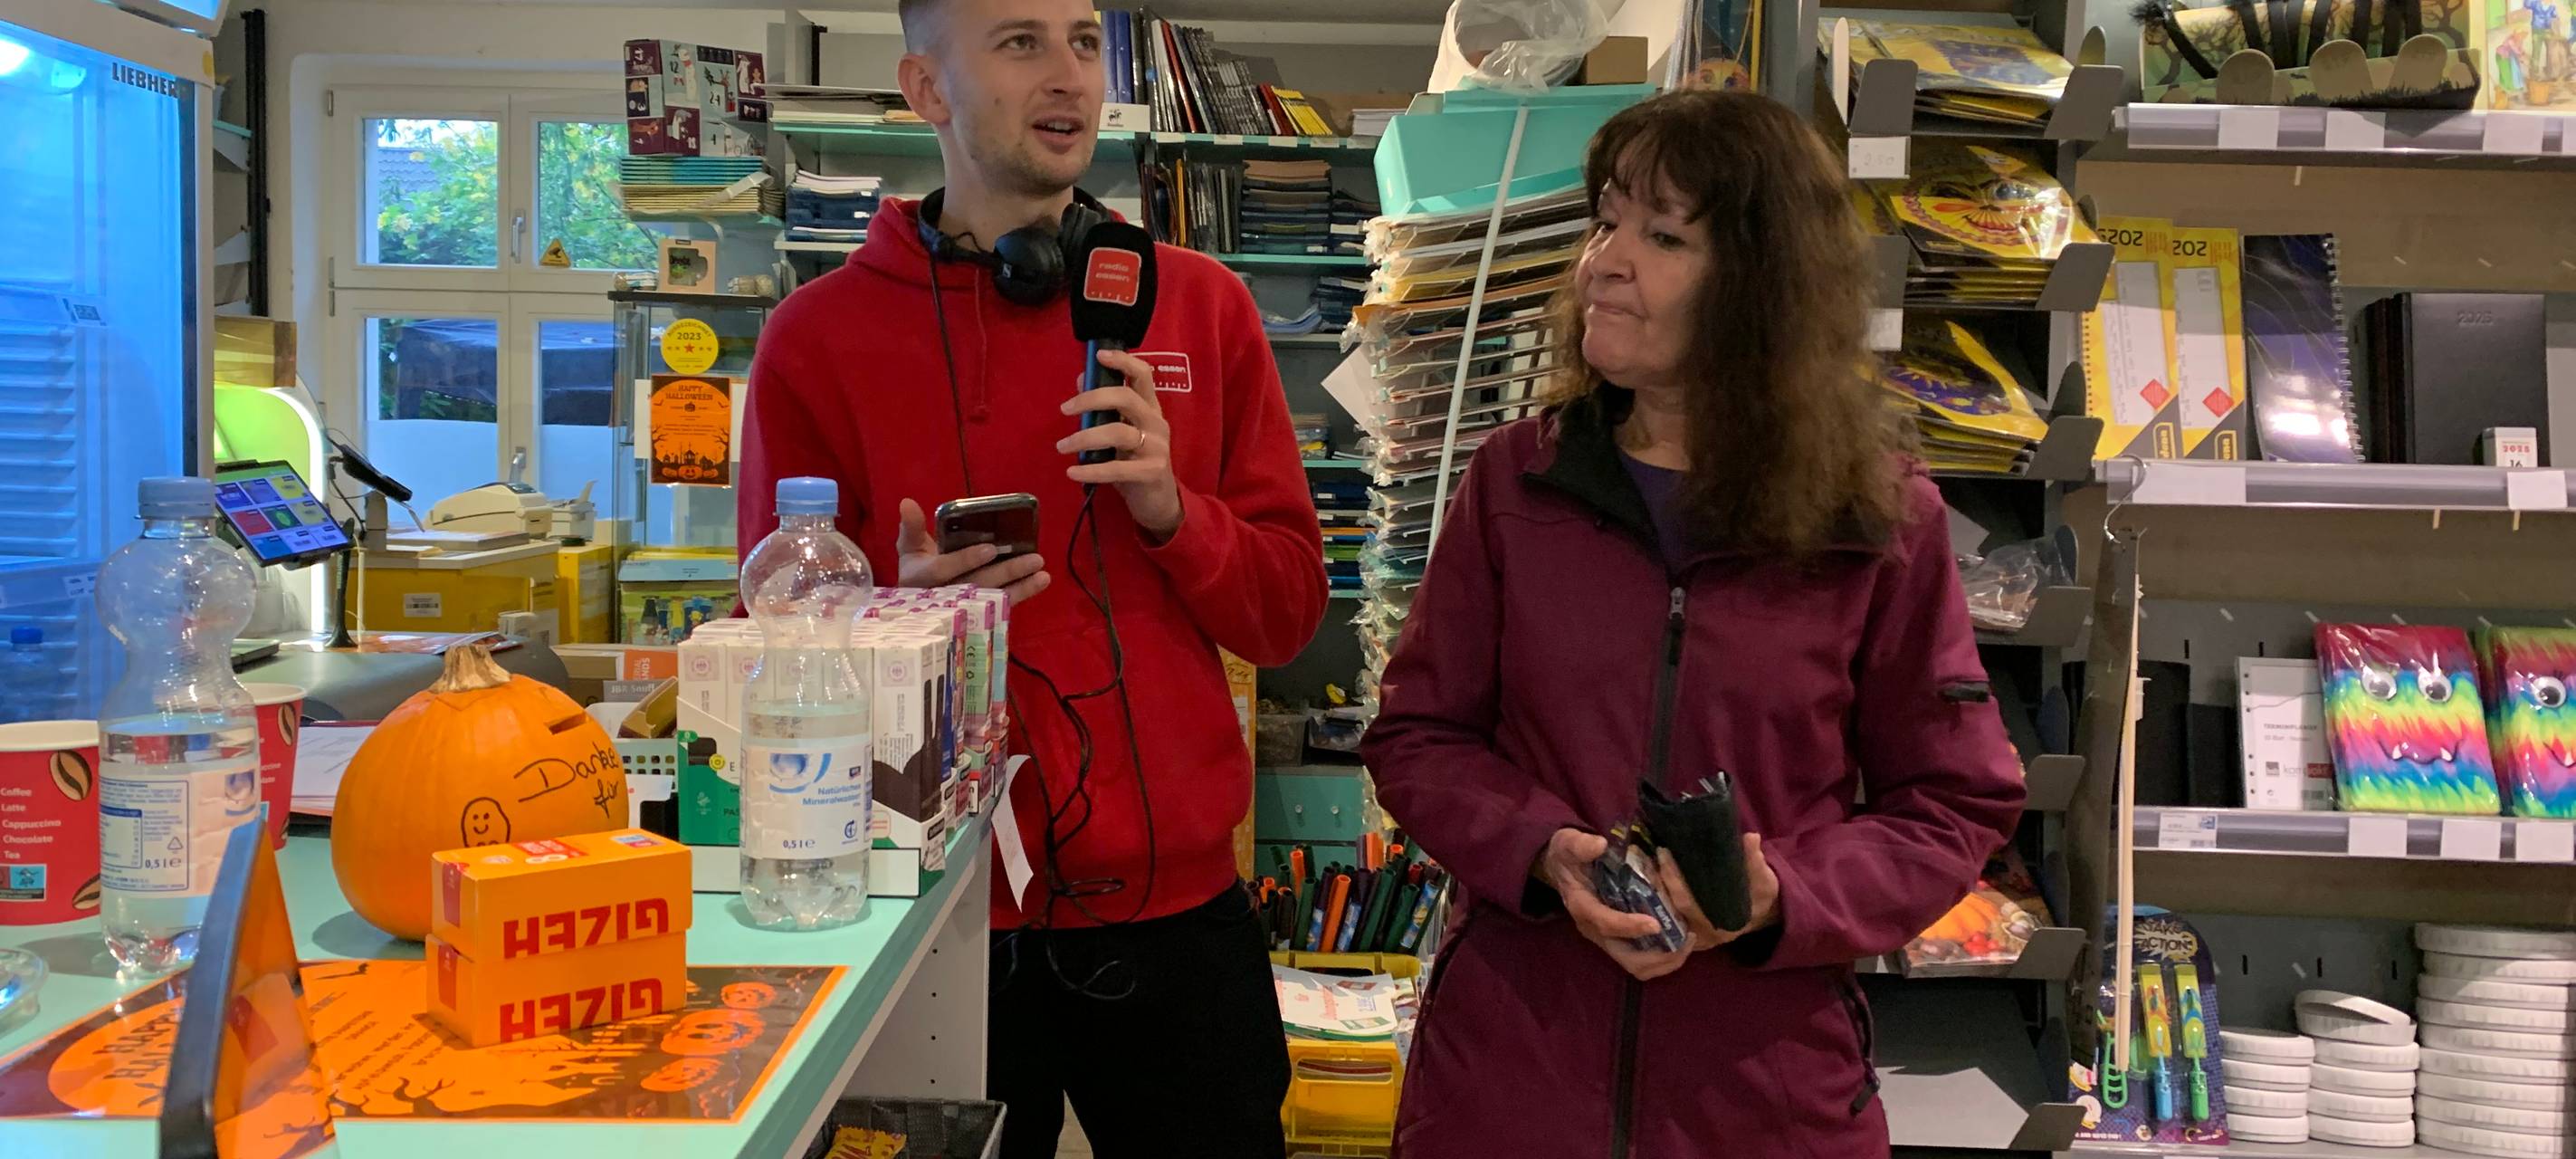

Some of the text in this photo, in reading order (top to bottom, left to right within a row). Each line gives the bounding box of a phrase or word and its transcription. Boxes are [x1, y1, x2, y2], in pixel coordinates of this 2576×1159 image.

[1098, 262, 1130, 273] radio
[1095, 273, 1131, 283] essen
[677, 331, 701, 341] 2023
[1158, 365, 1187, 374] essen
[665, 393, 714, 401] HALLOWEEN
[513, 741, 619, 803] Danke
[0, 787, 33, 798] Coffee
[1, 802, 27, 813] Latte
[2, 819, 62, 830] Cappuccino
[3, 834, 54, 844] Chocolate
[782, 839, 797, 849] 0,5
[4, 849, 22, 859] Tea
[145, 859, 161, 869] 0,5
[502, 897, 669, 960] GIZEH
[499, 977, 663, 1043] GIZEH
